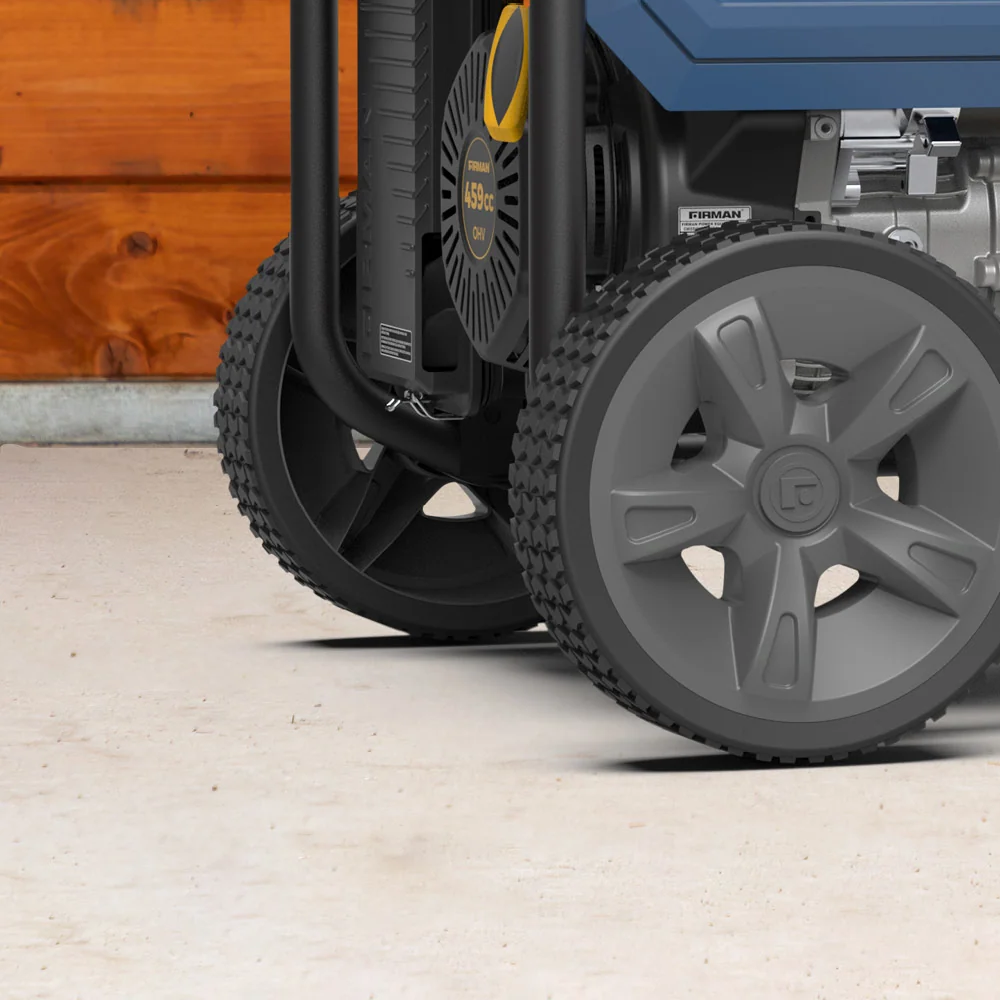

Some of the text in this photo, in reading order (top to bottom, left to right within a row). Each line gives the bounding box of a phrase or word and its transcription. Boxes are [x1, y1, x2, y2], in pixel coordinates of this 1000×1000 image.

[468, 160, 490, 173] FIRMAN
[465, 181, 494, 212] 459cc
[689, 211, 741, 219] FIRMAN
[472, 226, 486, 240] OHV
